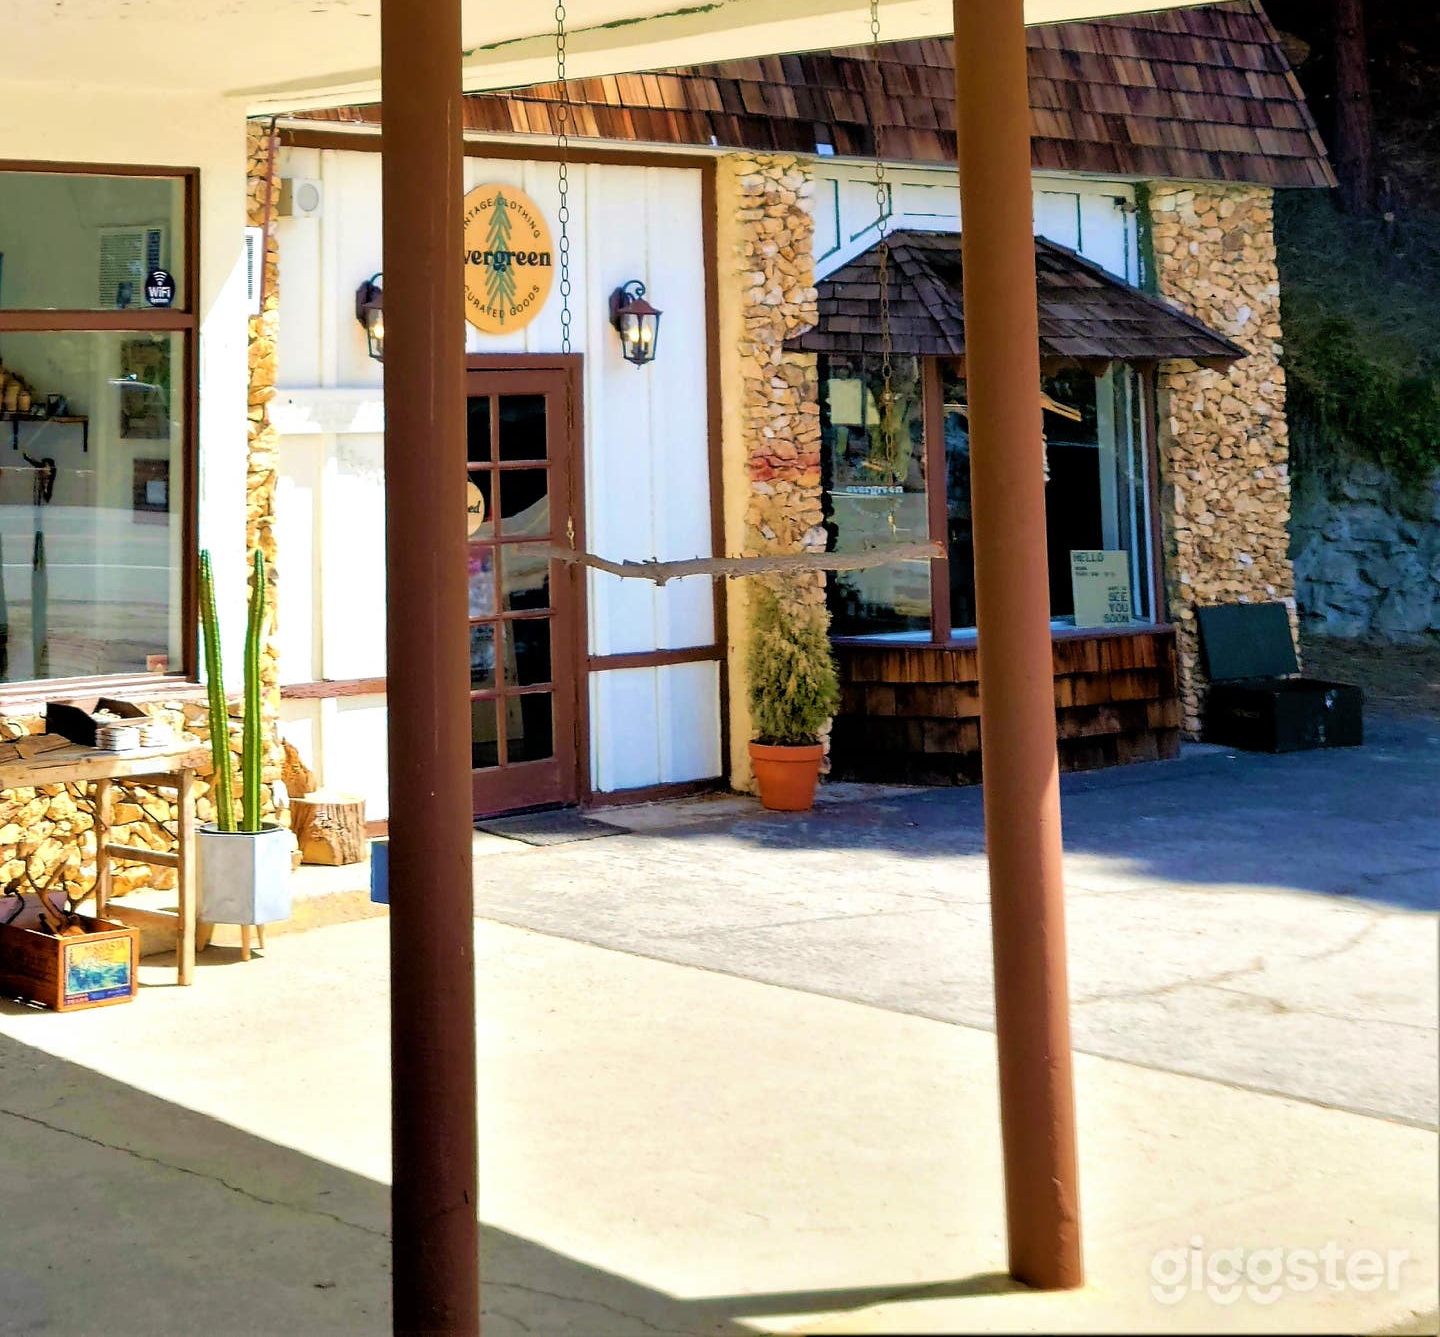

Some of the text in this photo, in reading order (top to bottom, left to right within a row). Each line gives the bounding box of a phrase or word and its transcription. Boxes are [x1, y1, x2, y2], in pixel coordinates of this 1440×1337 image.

[463, 197, 542, 239] NTAGE CLOTHING
[464, 249, 552, 273] vergreen
[509, 284, 541, 316] GOODS
[1073, 551, 1105, 563] HELLO
[1108, 602, 1129, 613] YOU
